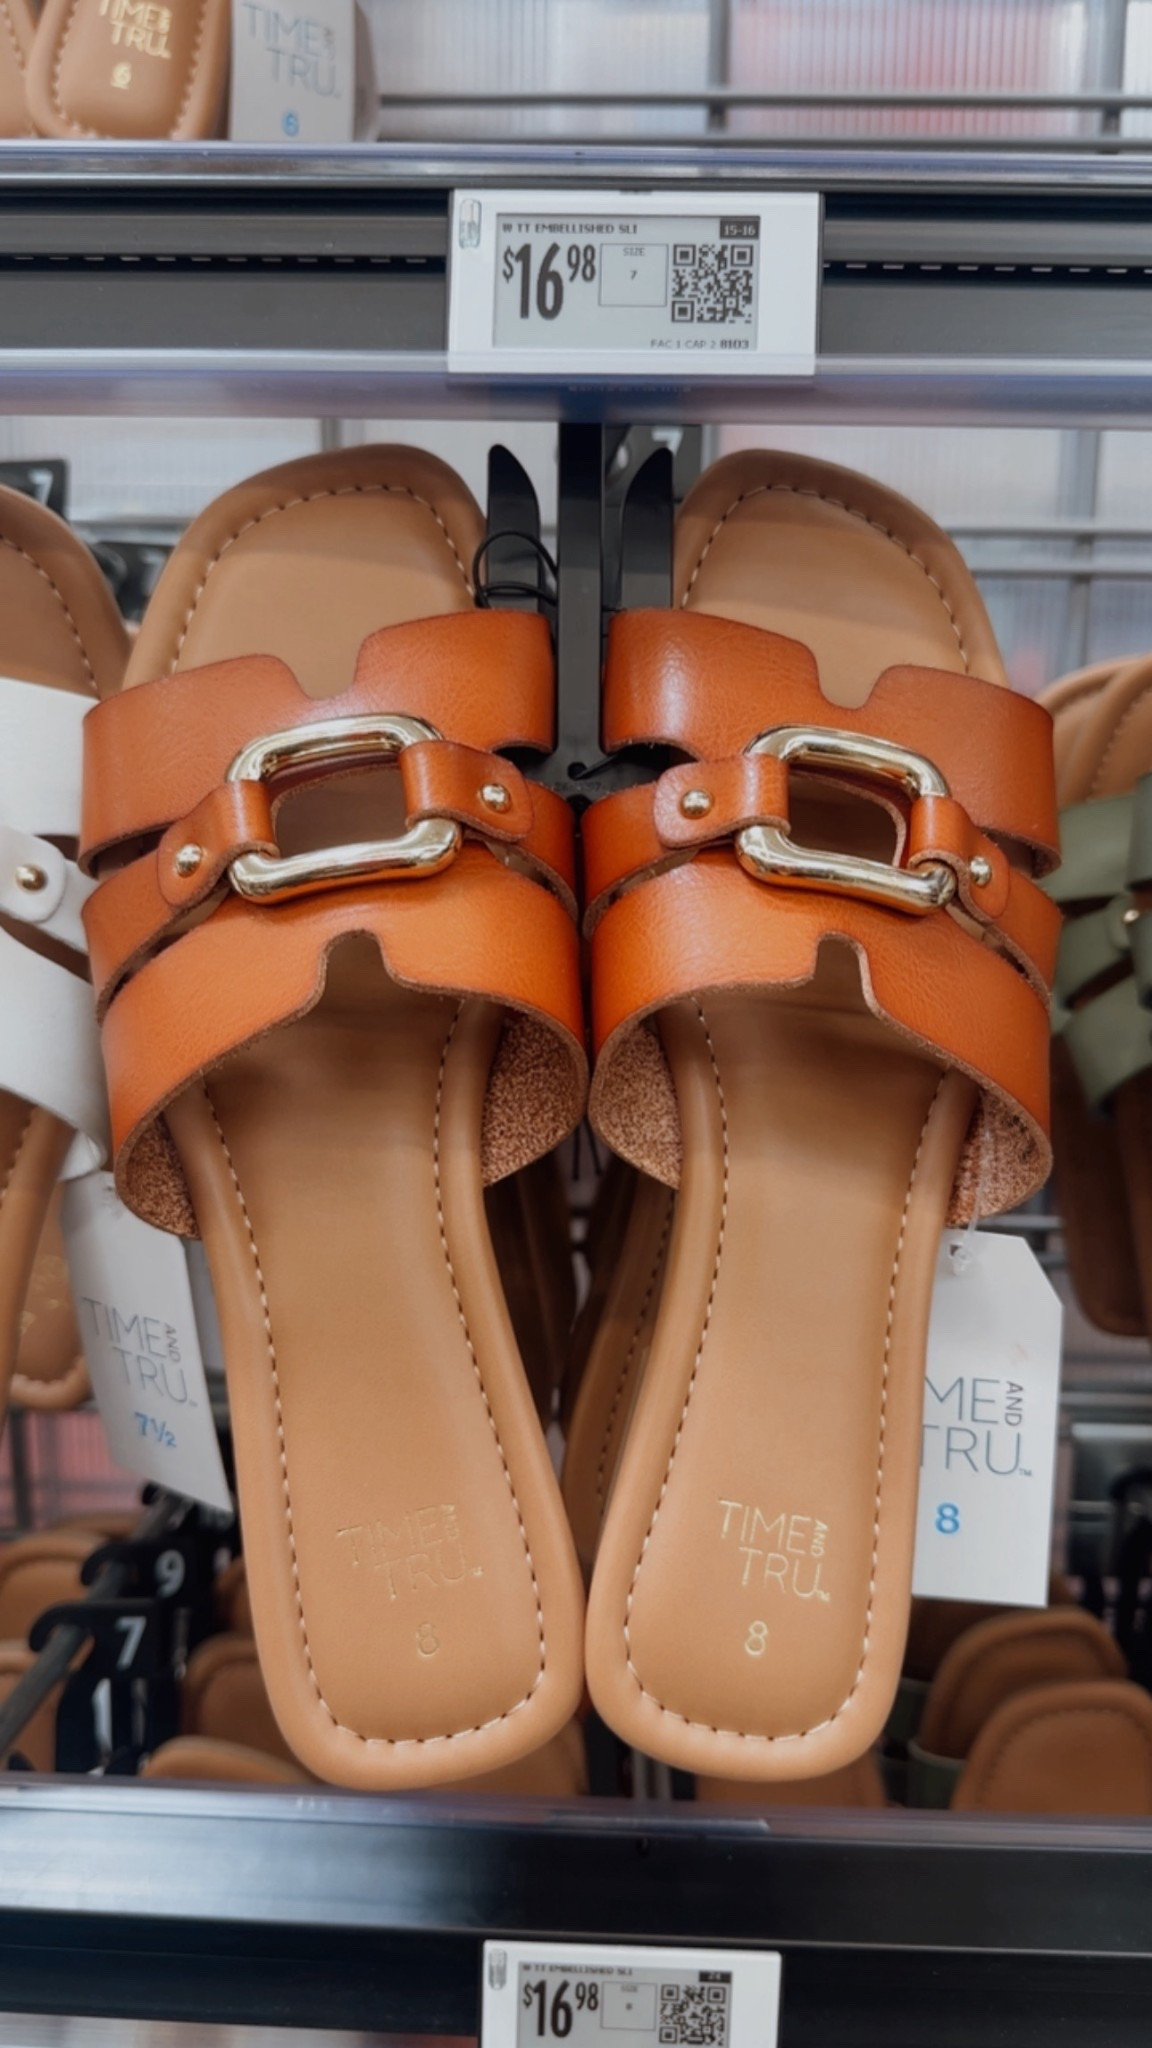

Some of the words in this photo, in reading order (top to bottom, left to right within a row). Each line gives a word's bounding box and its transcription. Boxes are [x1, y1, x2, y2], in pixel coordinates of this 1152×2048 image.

[241, 2, 322, 58] TIME
[282, 110, 300, 138] 6
[518, 223, 531, 233] TT
[535, 224, 614, 234] EMBELLISHED
[618, 224, 638, 235] SLI
[724, 224, 756, 237] 15-16
[623, 247, 646, 257] SIZE
[630, 269, 637, 280] 7
[650, 339, 672, 349] FAC
[82, 1296, 168, 1359] TIME
[164, 1322, 182, 1363] AND
[1004, 1380, 1024, 1427] AND
[336, 1504, 444, 1568] TIME
[718, 1497, 812, 1556] TIME
[935, 1502, 961, 1535] 8
[811, 1519, 828, 1558] AND
[155, 1549, 186, 1599] 9
[115, 1615, 147, 1671] 7
[415, 1621, 440, 1660] 8
[744, 1619, 769, 1657] 8
